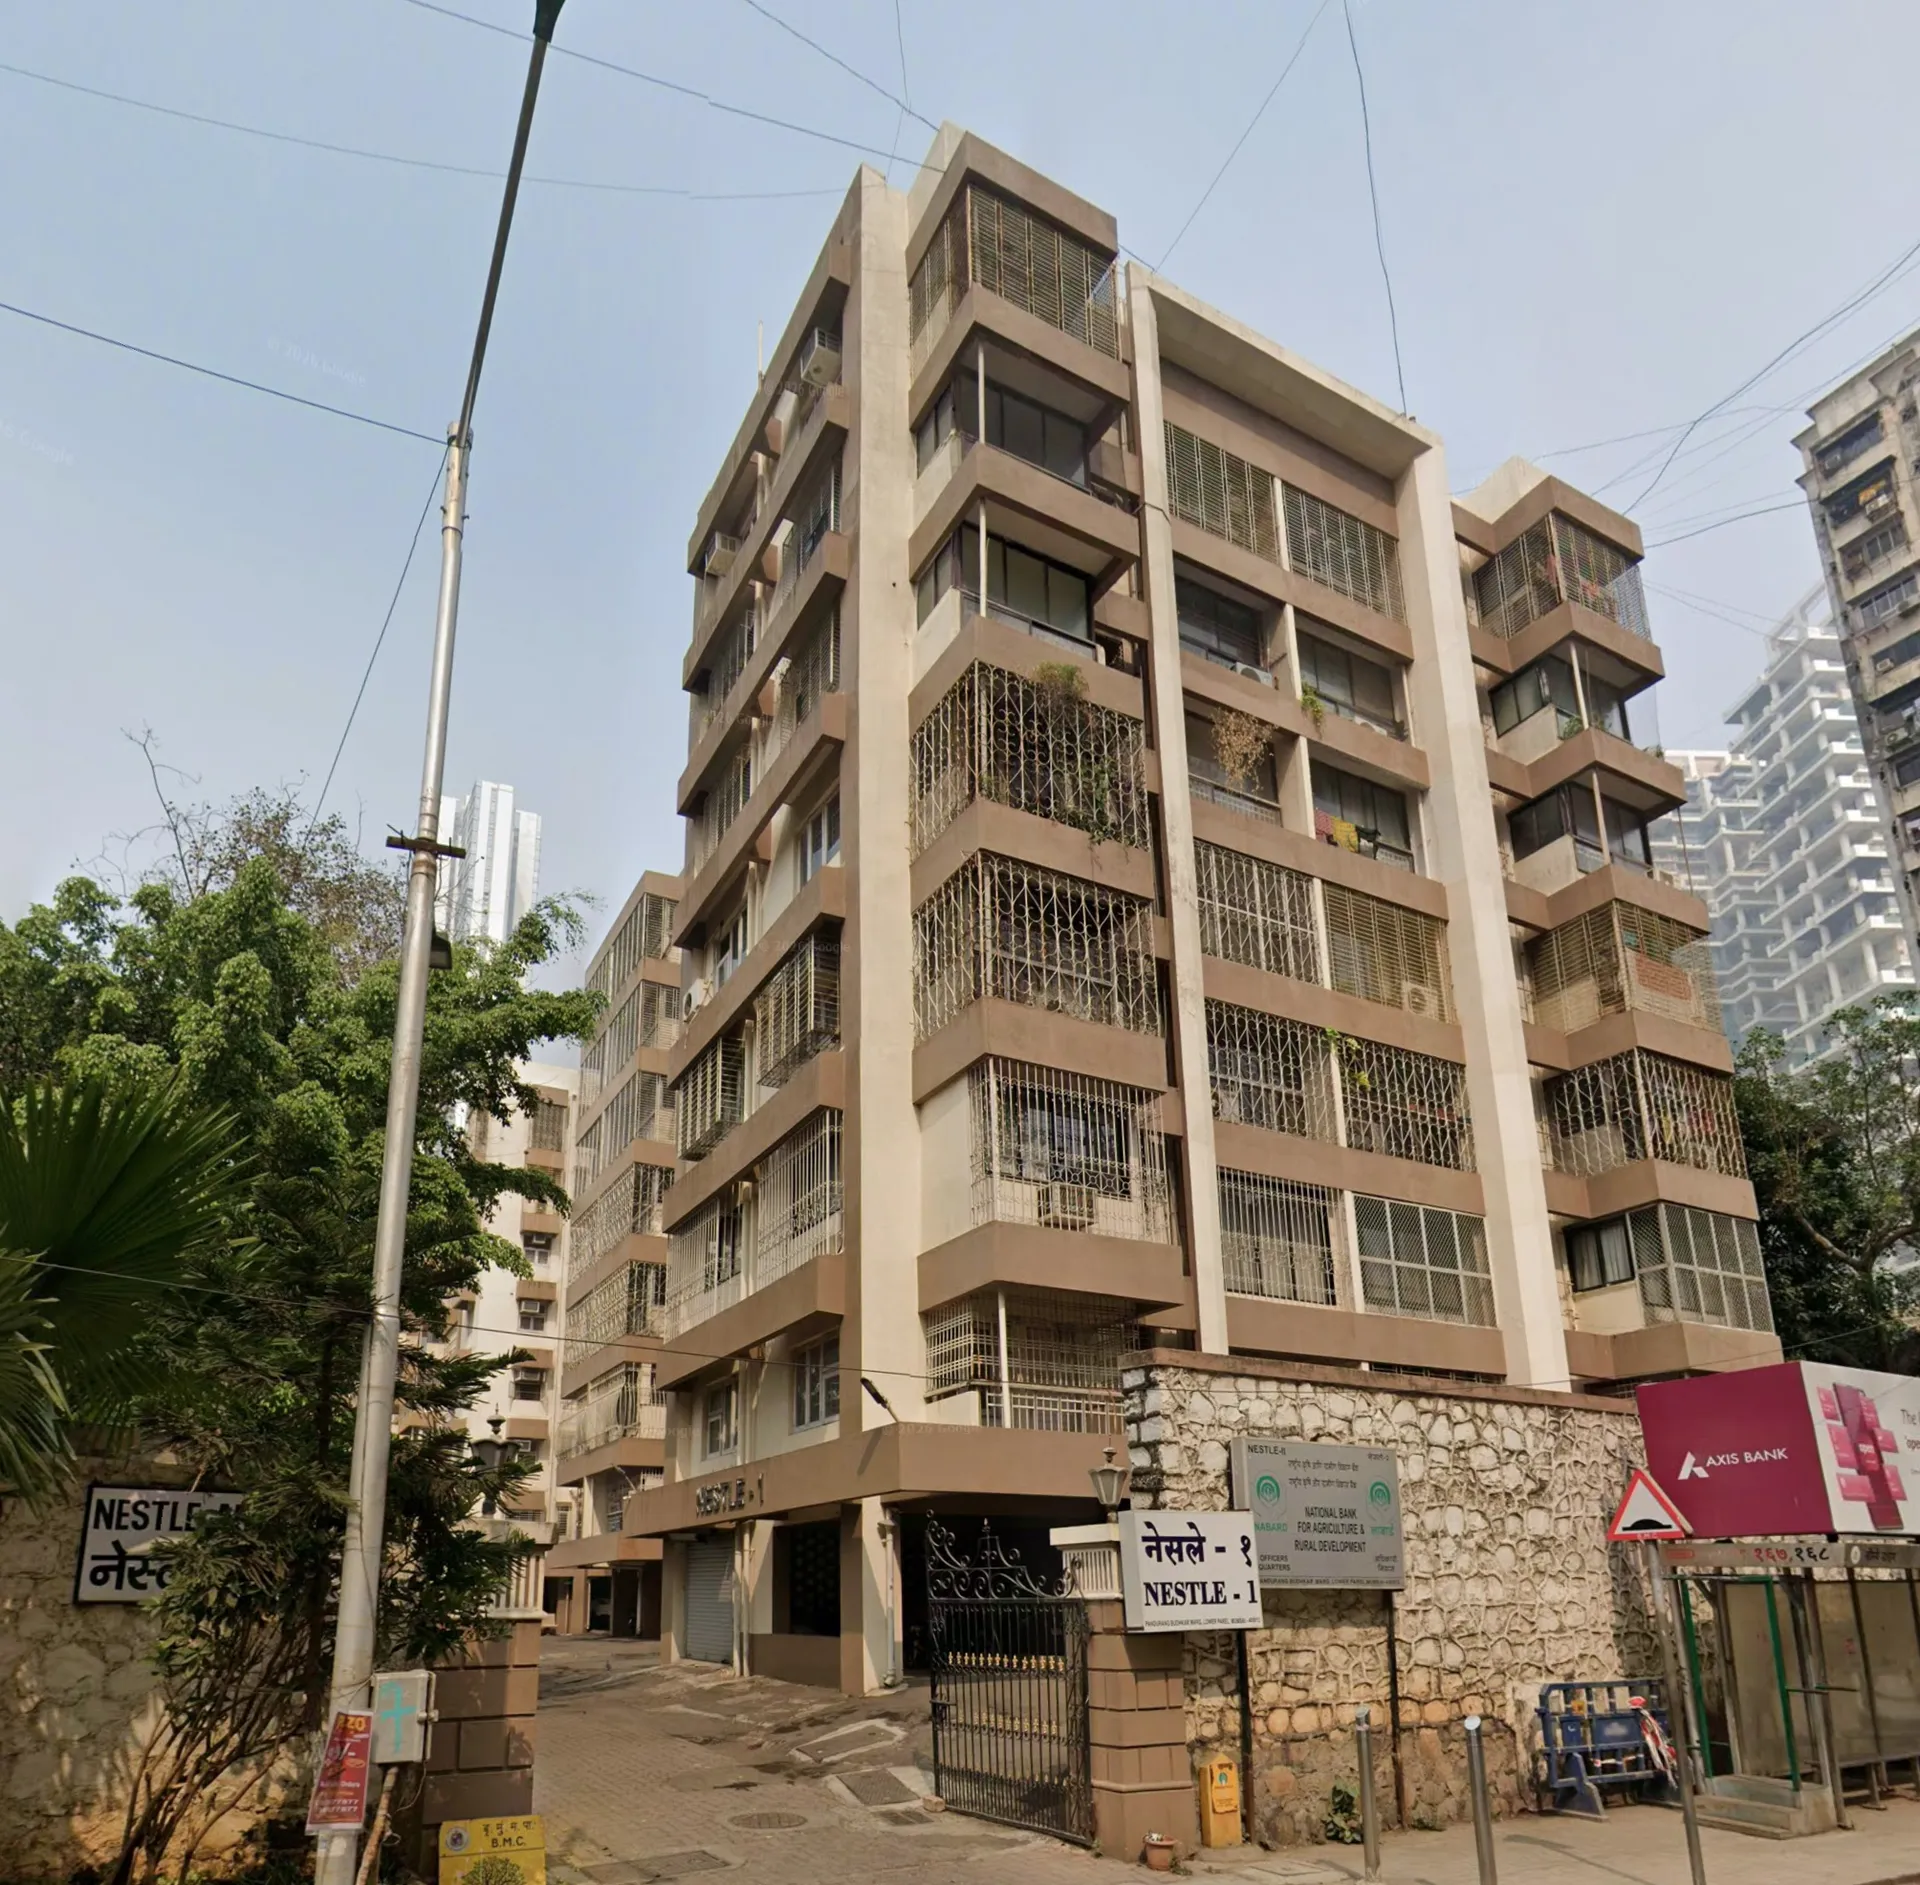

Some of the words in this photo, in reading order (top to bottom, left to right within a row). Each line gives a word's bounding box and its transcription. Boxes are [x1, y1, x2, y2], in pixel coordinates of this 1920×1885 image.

[1706, 1452, 1740, 1467] AXIS
[1743, 1447, 1788, 1463] BANK
[1305, 1506, 1338, 1519] NATIONAL
[1339, 1508, 1357, 1519] BANK
[1297, 1521, 1311, 1533] FOR
[1312, 1523, 1358, 1535] AGRICULTURE
[1294, 1540, 1317, 1552] RURAL
[1319, 1541, 1366, 1553] DEVELOPMENT
[1143, 1581, 1228, 1607] NESTLE
[1247, 1580, 1258, 1604] 1
